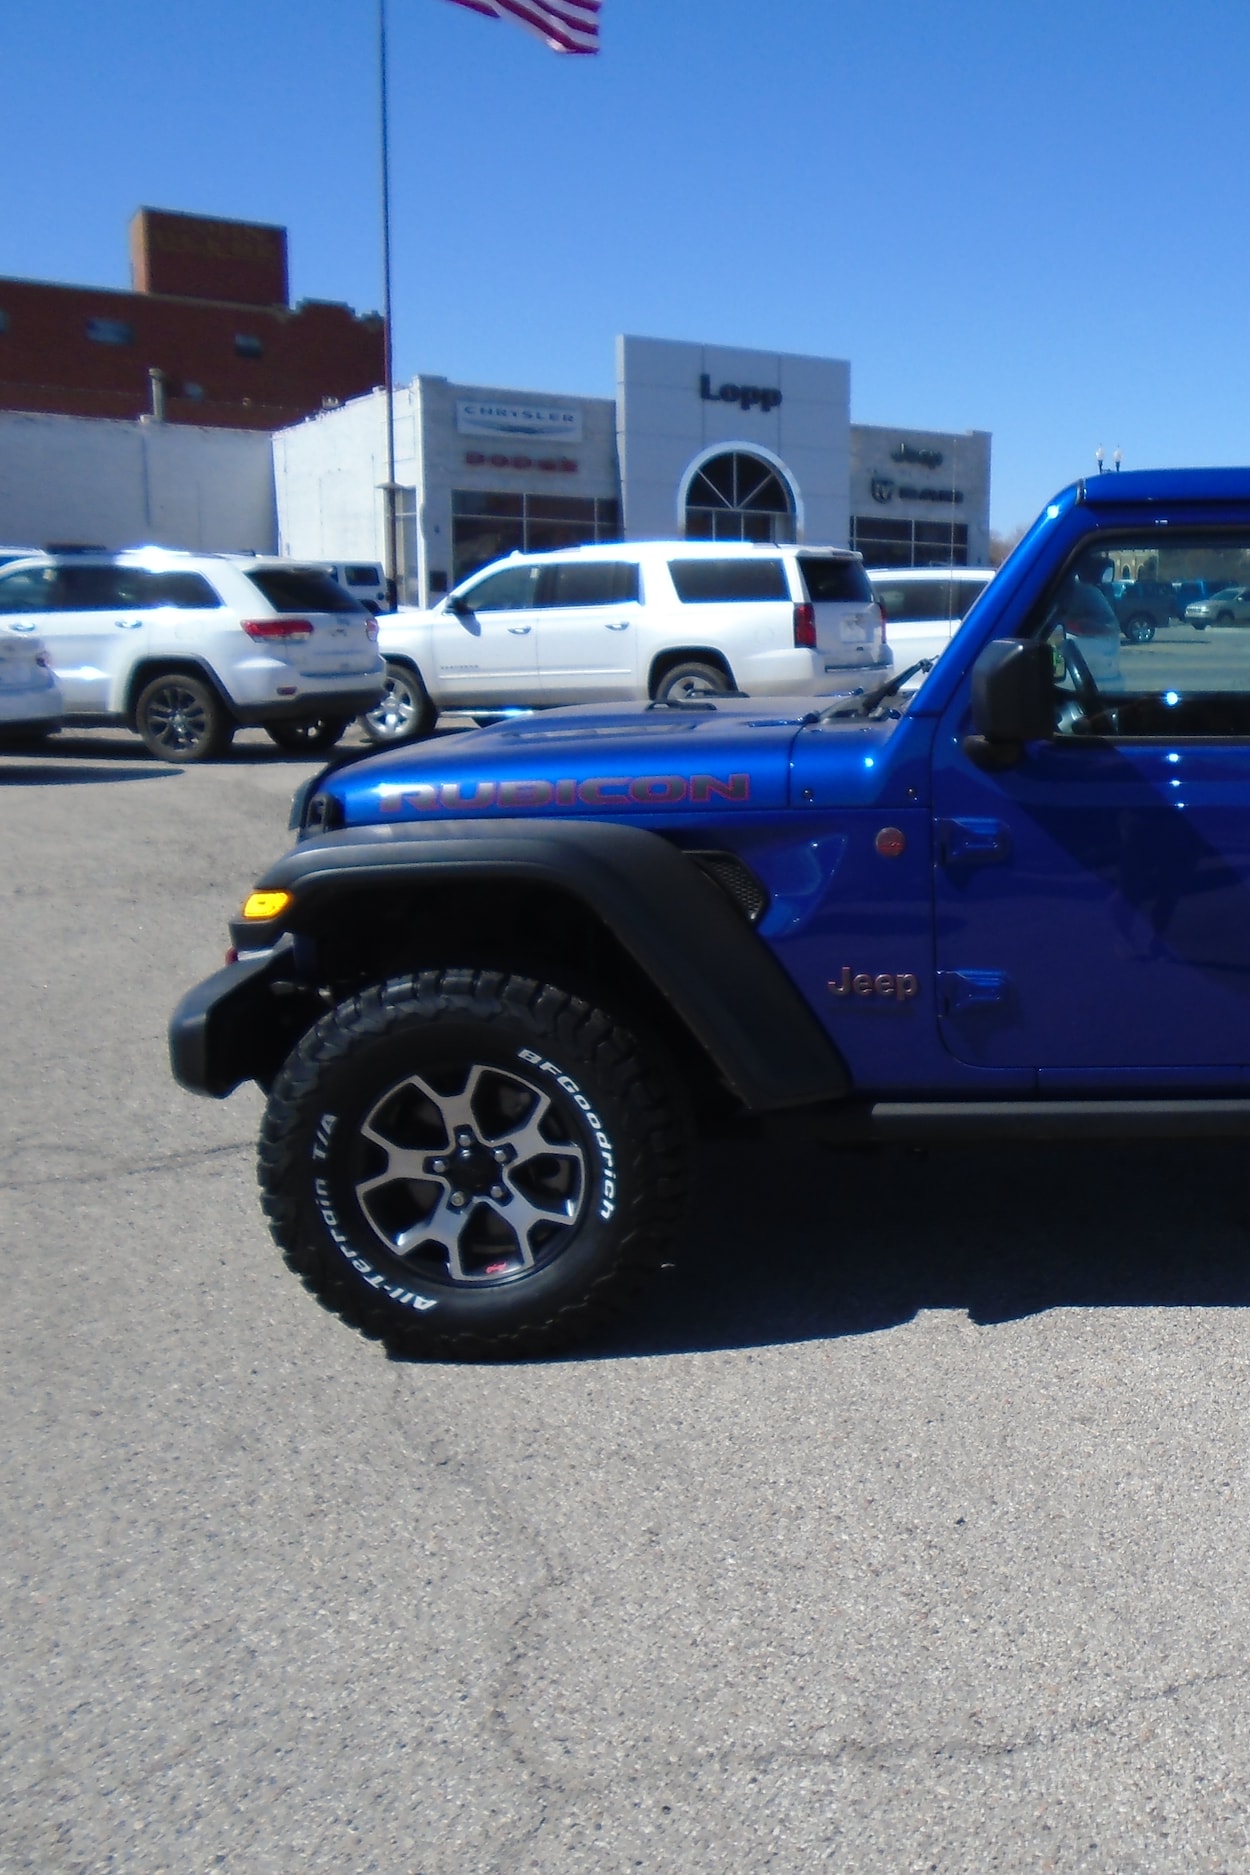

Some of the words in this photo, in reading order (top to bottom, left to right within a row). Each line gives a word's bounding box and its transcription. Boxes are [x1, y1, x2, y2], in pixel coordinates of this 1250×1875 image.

[699, 373, 783, 412] Lopp
[464, 406, 574, 422] CHRYSLER
[377, 773, 751, 812] RUBICON
[827, 966, 919, 1003] Jeep
[311, 1113, 339, 1161] T/A
[517, 1049, 617, 1220] BFGoodrich
[314, 1178, 438, 1311] All-Terrain
